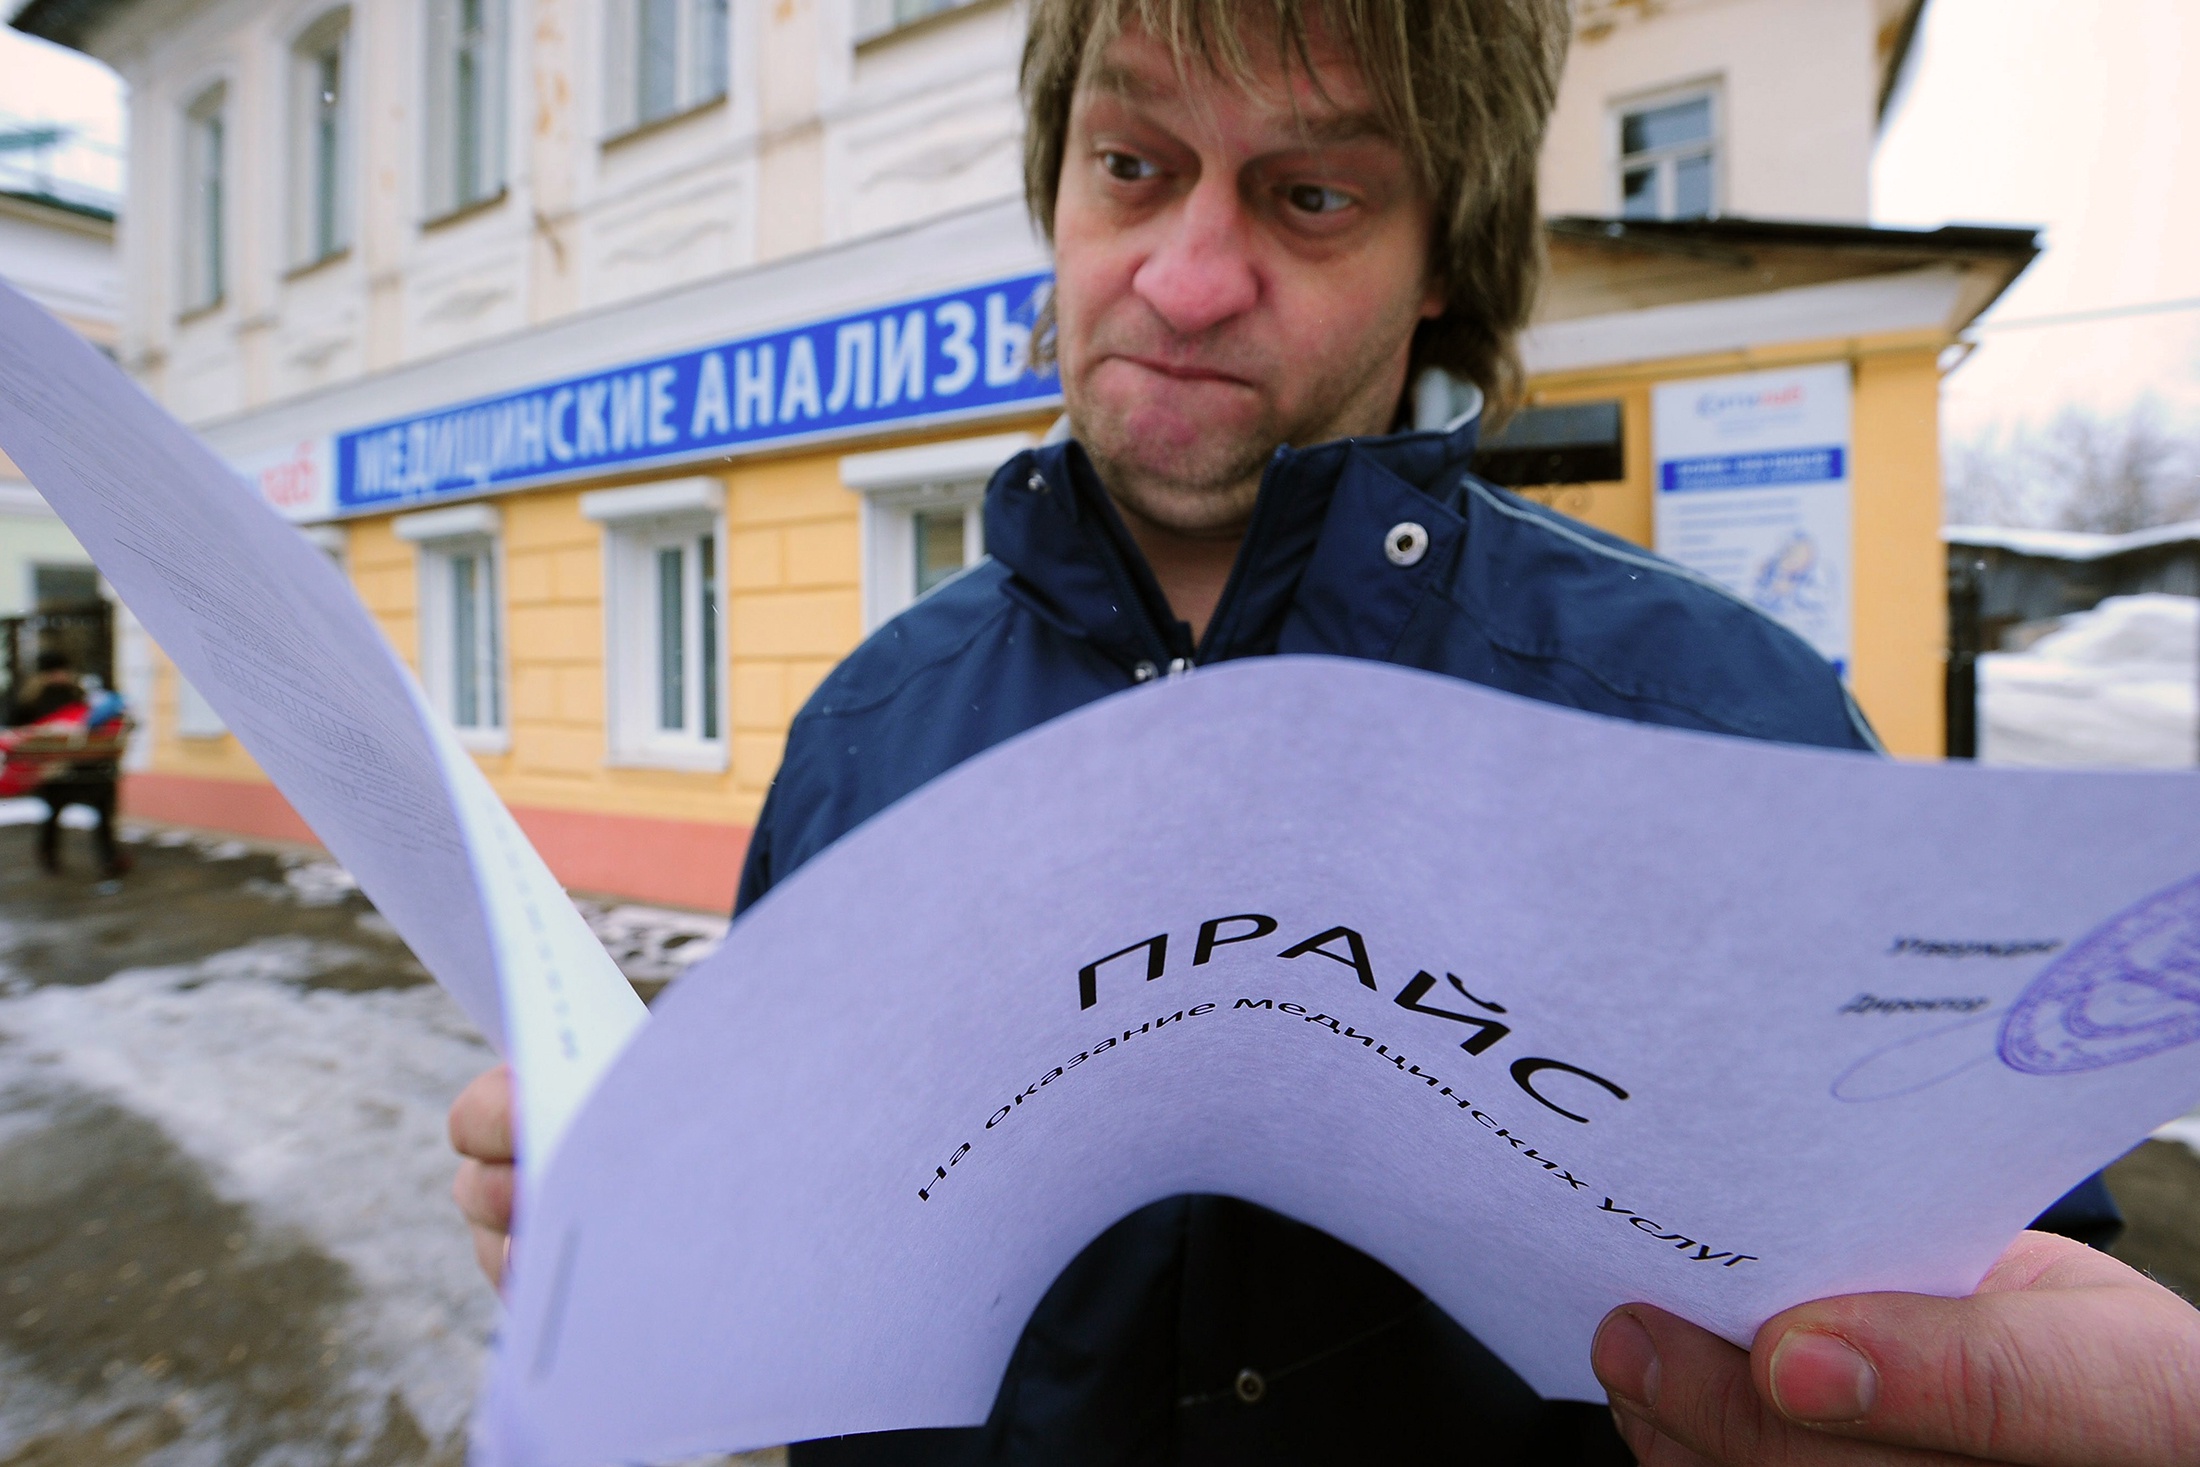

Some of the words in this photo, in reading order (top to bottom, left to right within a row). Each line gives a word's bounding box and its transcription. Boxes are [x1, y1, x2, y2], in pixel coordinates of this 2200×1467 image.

[352, 364, 677, 499] МЕДИЦИНСКИЕ
[1078, 913, 1630, 1124] ПРАЙС
[917, 1142, 971, 1202] На
[985, 1003, 1216, 1130] оказание
[1233, 998, 1590, 1191] медицинских
[1596, 1196, 1759, 1267] услуг
